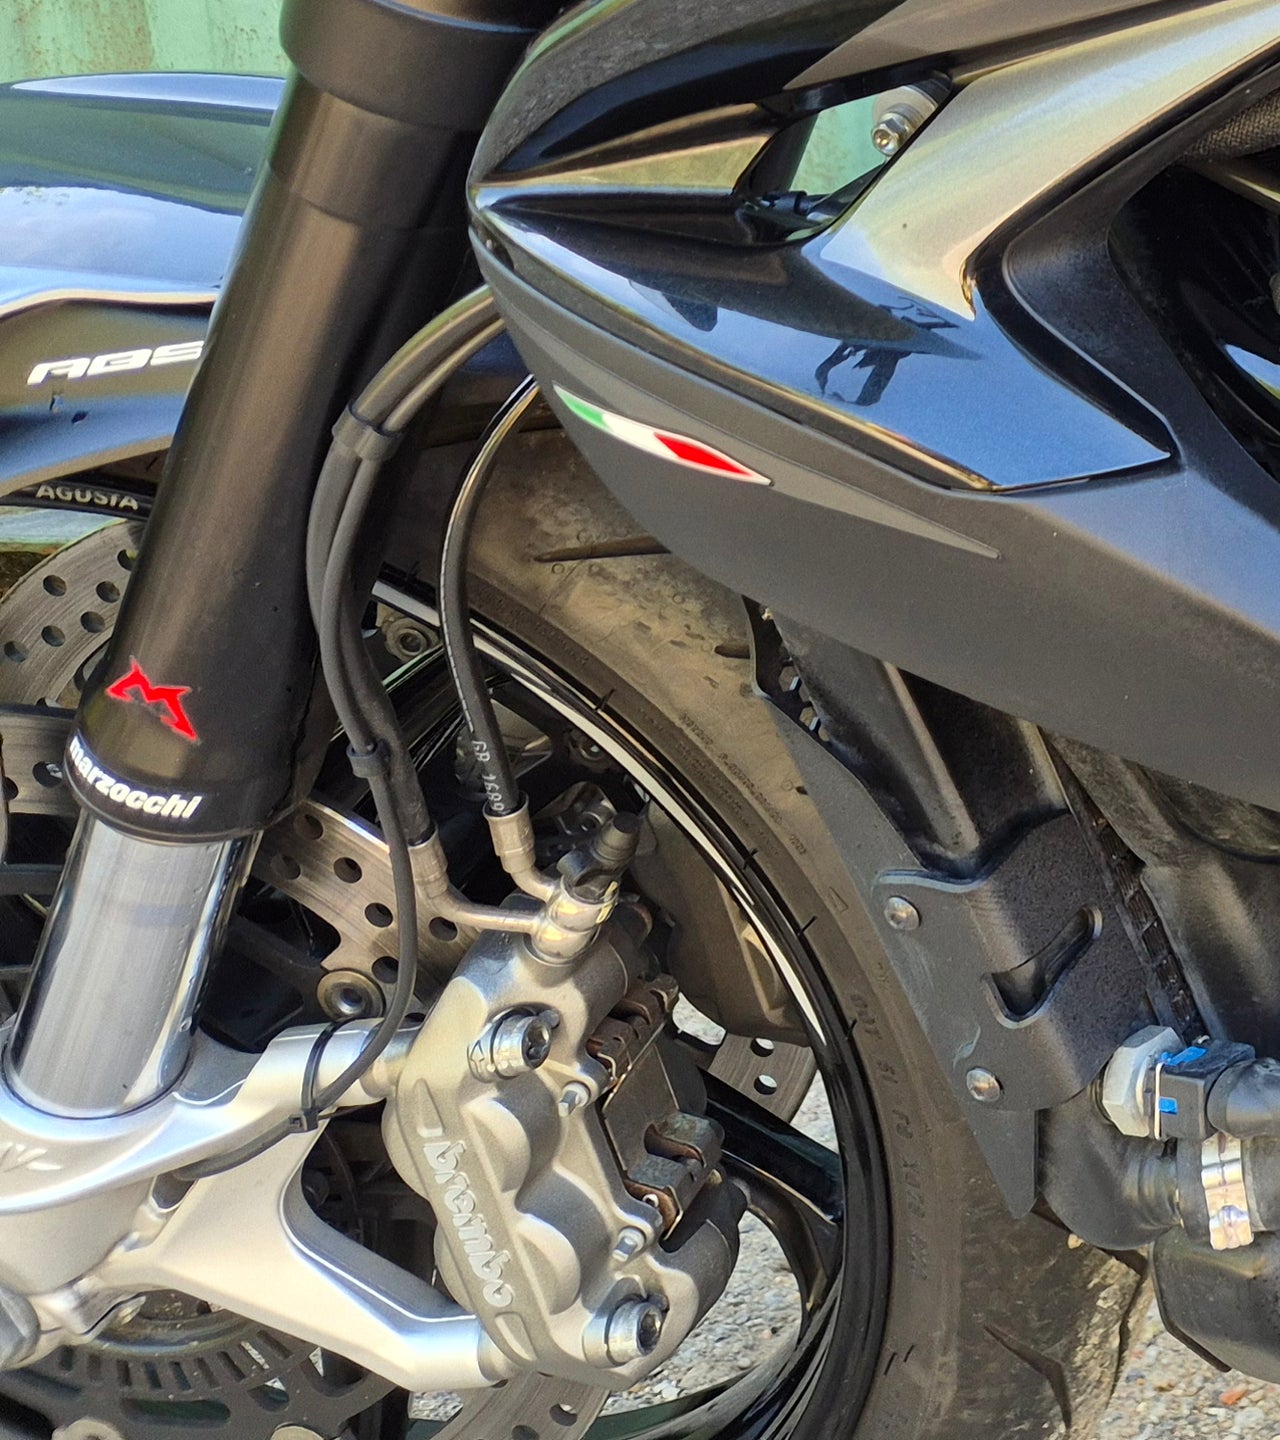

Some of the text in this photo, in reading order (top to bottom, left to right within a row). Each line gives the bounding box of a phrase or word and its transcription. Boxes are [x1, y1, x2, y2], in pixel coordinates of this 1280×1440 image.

[27, 340, 205, 386] ABS
[69, 735, 203, 819] marzocchi
[422, 1140, 515, 1307] brembo
